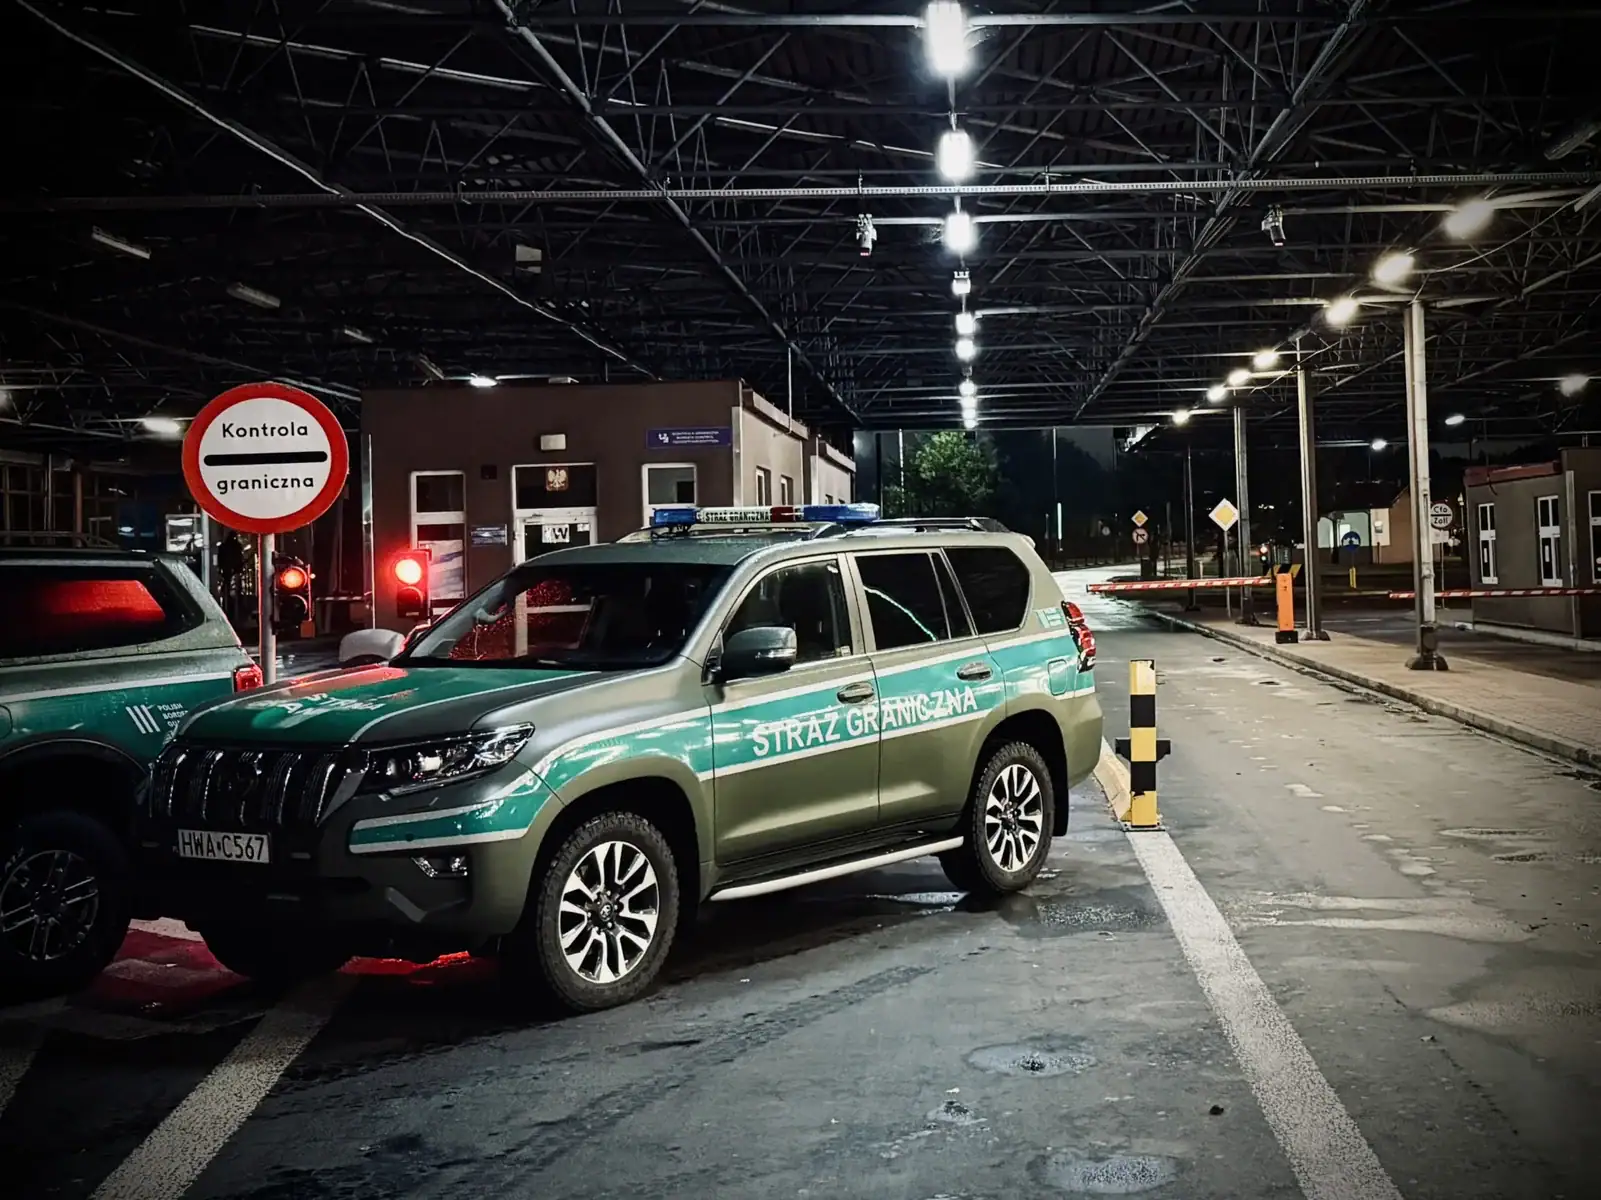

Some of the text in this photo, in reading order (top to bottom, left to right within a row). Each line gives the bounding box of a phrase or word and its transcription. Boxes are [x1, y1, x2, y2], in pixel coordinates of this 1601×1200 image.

[222, 422, 308, 438] Kontrola
[217, 474, 314, 495] graniczna
[157, 703, 184, 711] POLISH
[752, 686, 978, 757] STRAŻ GRANICZNA
